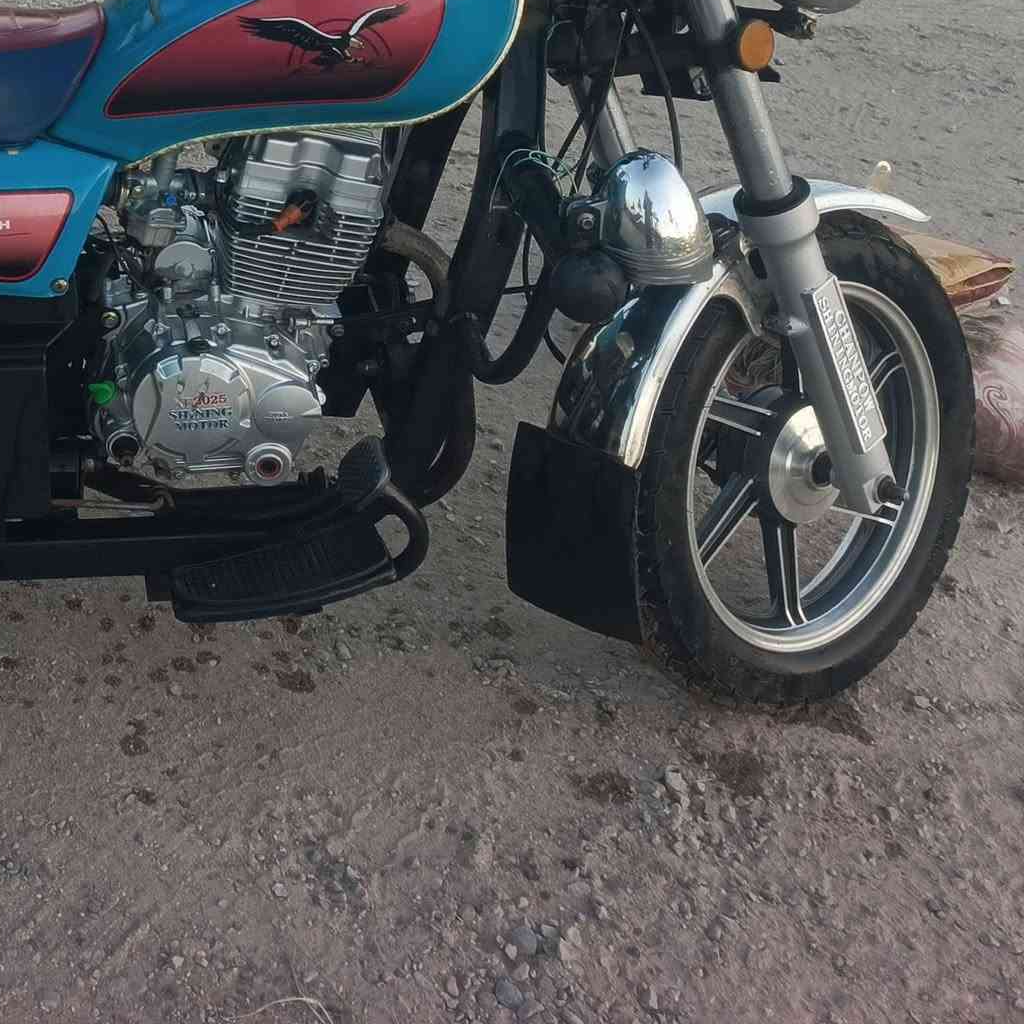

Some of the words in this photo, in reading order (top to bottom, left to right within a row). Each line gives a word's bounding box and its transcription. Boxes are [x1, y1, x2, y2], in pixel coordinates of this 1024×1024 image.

[818, 297, 873, 442] SHININGMOTOR
[834, 310, 876, 410] CHANPOW
[175, 420, 231, 431] MOTOR
[192, 395, 226, 408] 2025
